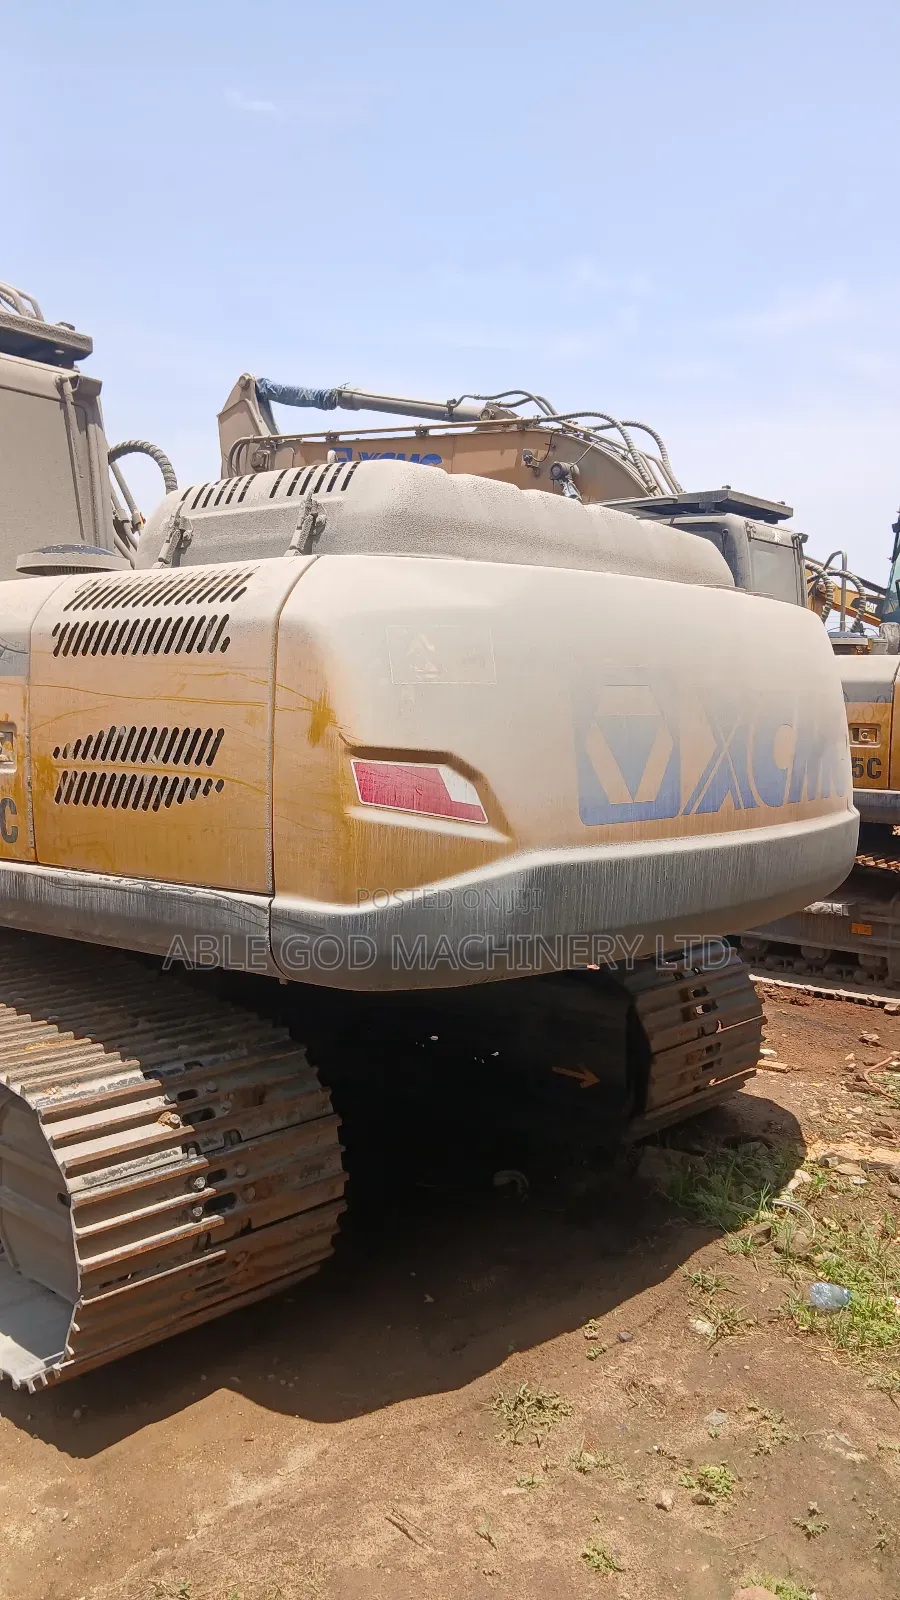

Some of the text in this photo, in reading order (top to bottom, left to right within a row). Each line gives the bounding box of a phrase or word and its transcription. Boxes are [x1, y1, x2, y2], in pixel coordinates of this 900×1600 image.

[865, 601, 878, 614] CAT
[679, 686, 846, 816] XCM
[852, 757, 882, 779] 5C
